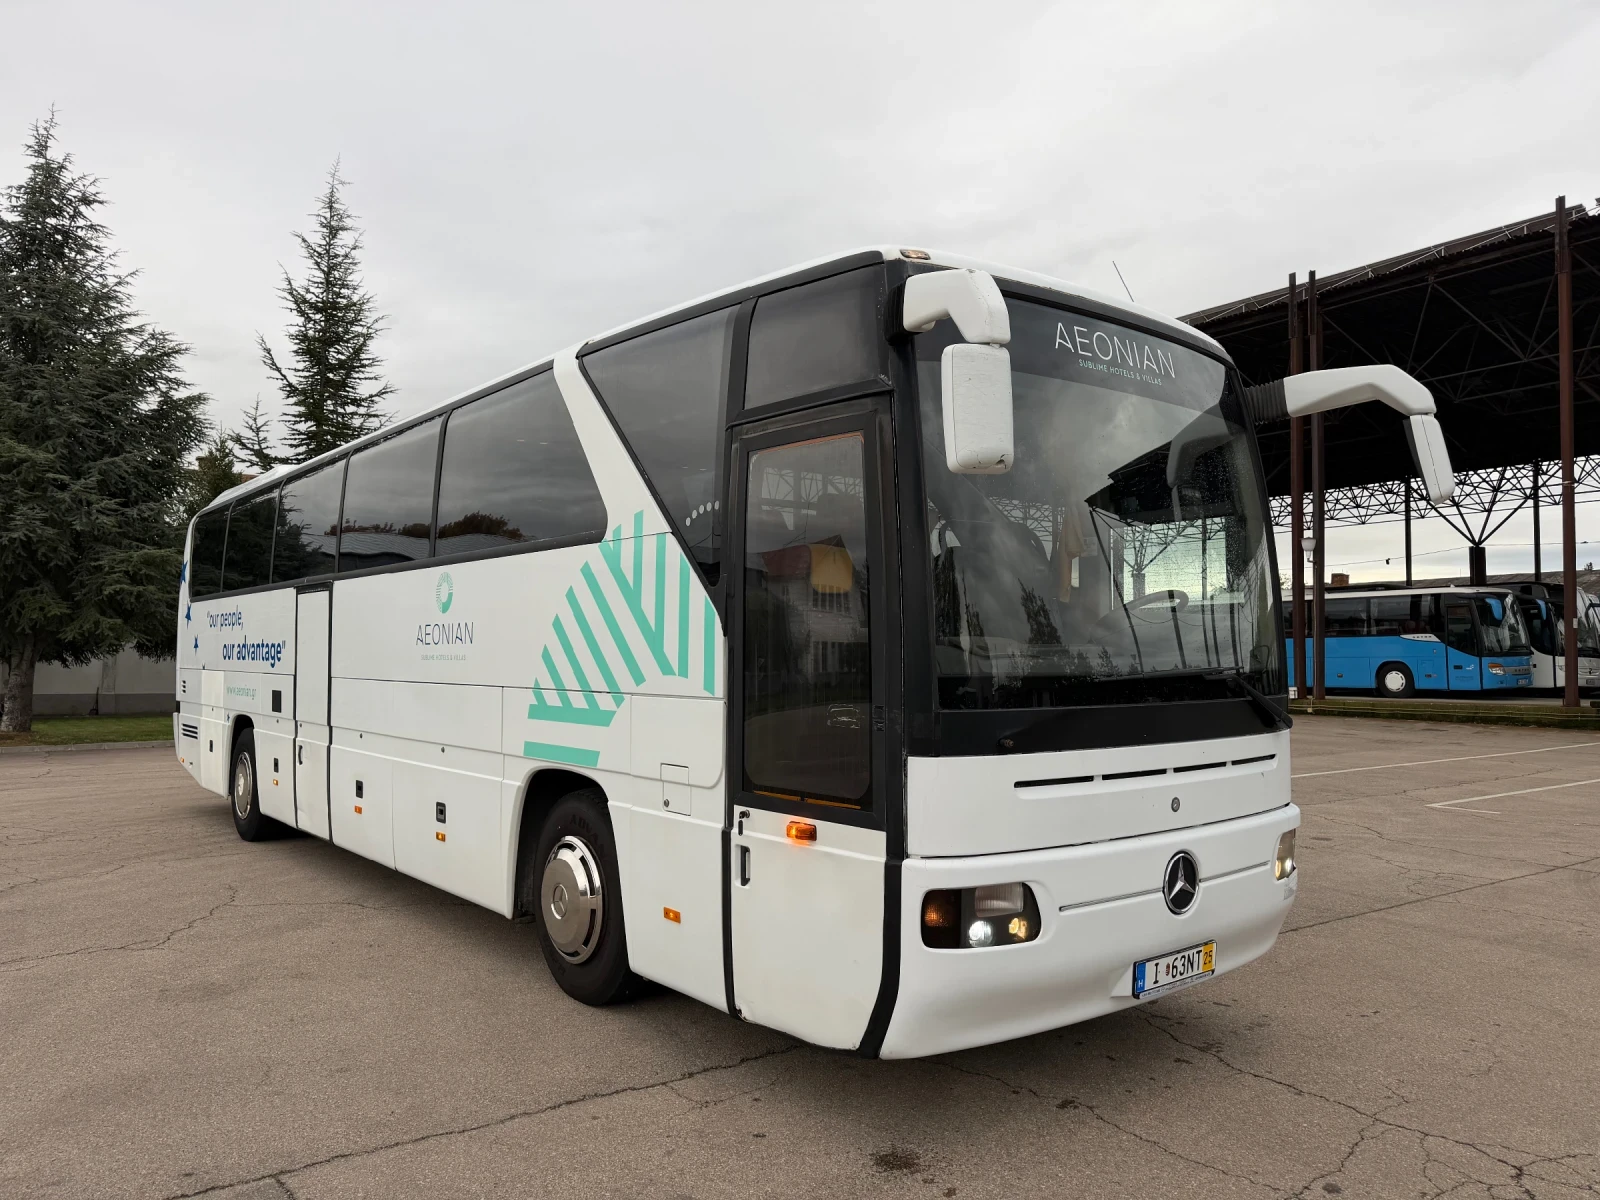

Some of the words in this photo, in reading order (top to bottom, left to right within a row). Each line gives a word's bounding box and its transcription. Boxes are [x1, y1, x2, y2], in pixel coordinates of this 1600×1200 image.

[1055, 322, 1176, 379] AEONIAN
[1078, 358, 1108, 373] SUBLIME
[1109, 364, 1135, 379] HOTELS
[1135, 372, 1141, 380] &
[1141, 374, 1163, 386] VILLAS
[219, 604, 243, 632] people,
[415, 621, 474, 646] AEONIAN
[222, 643, 235, 661] our
[236, 634, 286, 669] advantage"
[1153, 962, 1160, 985] I
[1171, 949, 1203, 979] 63NT
[1203, 949, 1213, 965] 25
[1138, 979, 1144, 988] H
